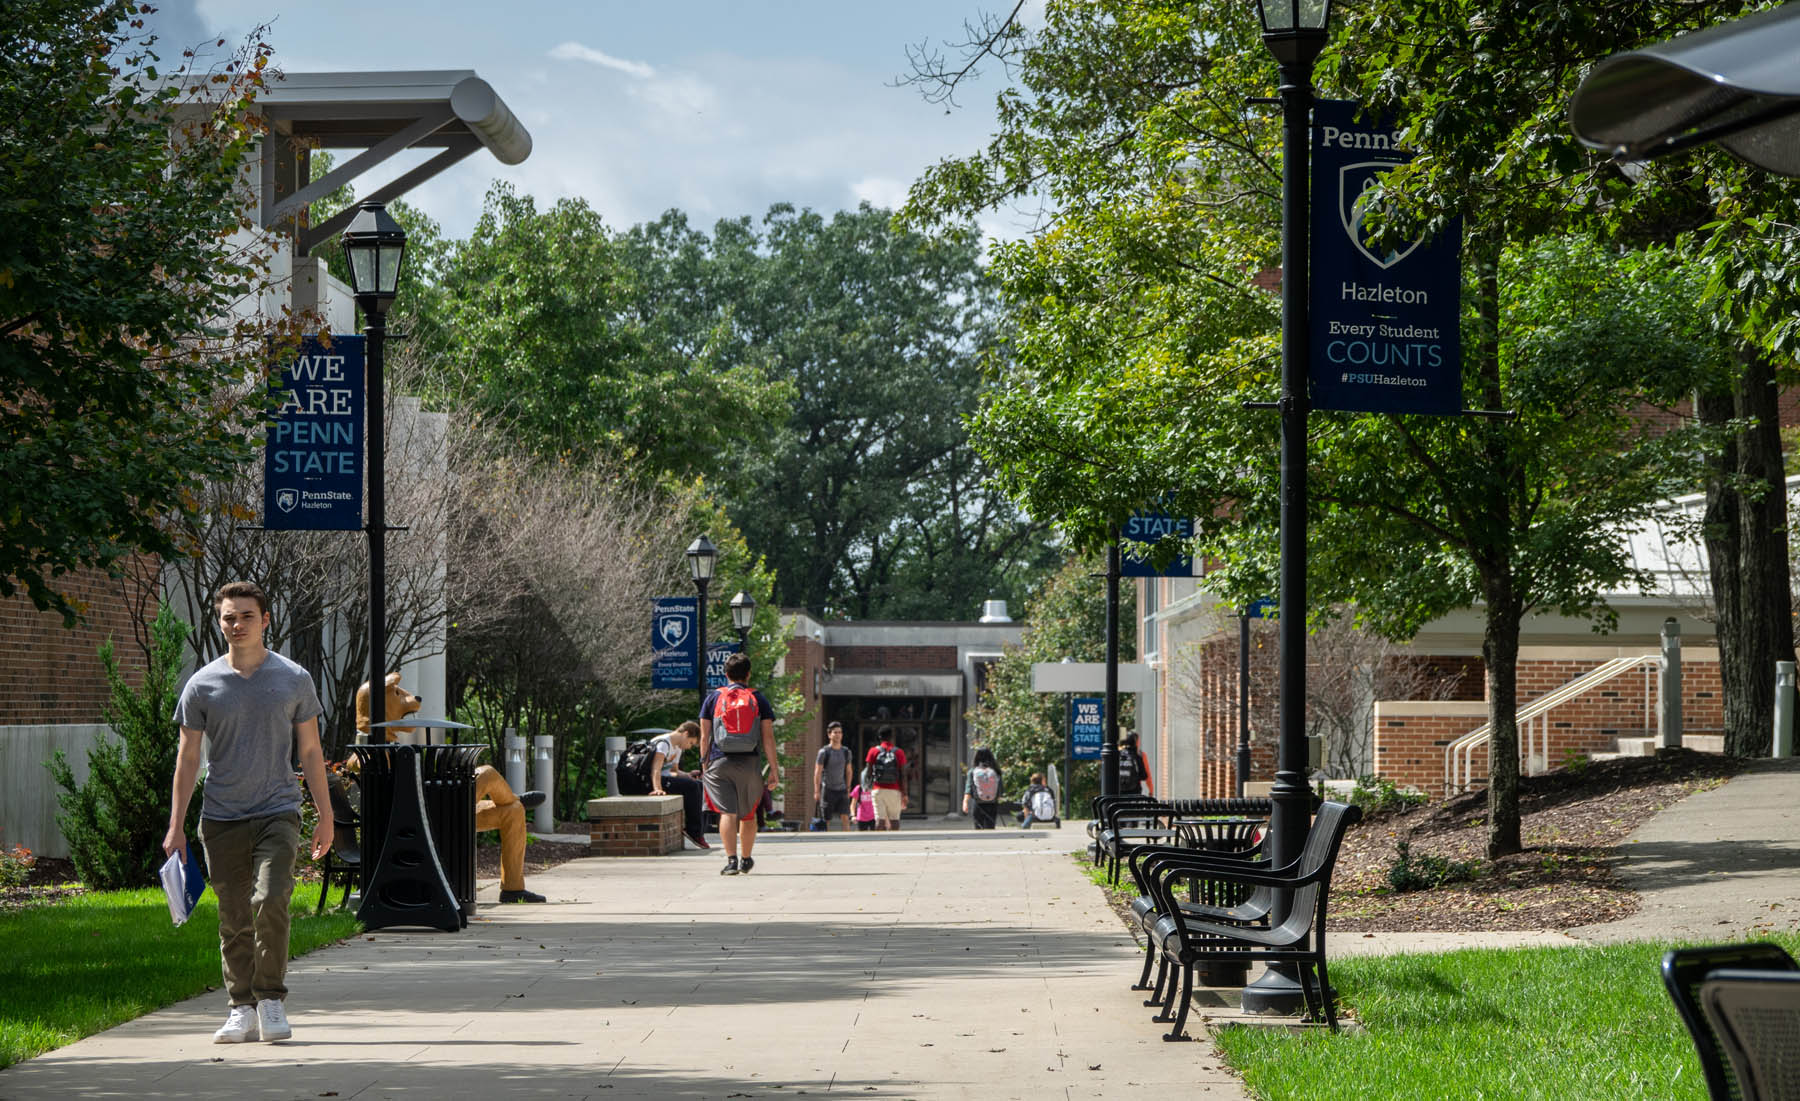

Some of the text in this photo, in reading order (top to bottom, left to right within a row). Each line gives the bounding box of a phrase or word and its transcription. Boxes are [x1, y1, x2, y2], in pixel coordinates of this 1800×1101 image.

[1322, 126, 1412, 151] PennS
[1341, 281, 1428, 304] Hazleton
[1328, 321, 1440, 339] Every Student
[1327, 340, 1442, 367] COUNTS
[290, 355, 345, 381] WE
[1341, 372, 1428, 387] #PSUHazleton
[278, 388, 353, 415] ARE
[275, 421, 354, 445] PENN
[273, 450, 356, 475] STATE
[301, 490, 353, 500] PennState
[301, 501, 333, 509] Hazleton
[1128, 517, 1188, 536] STATE
[654, 604, 696, 614] PennState
[705, 664, 726, 676] AR
[1077, 703, 1098, 714] WE
[1075, 714, 1100, 724] ARE
[1074, 724, 1100, 733] PENN
[1074, 734, 1100, 743] STATE
